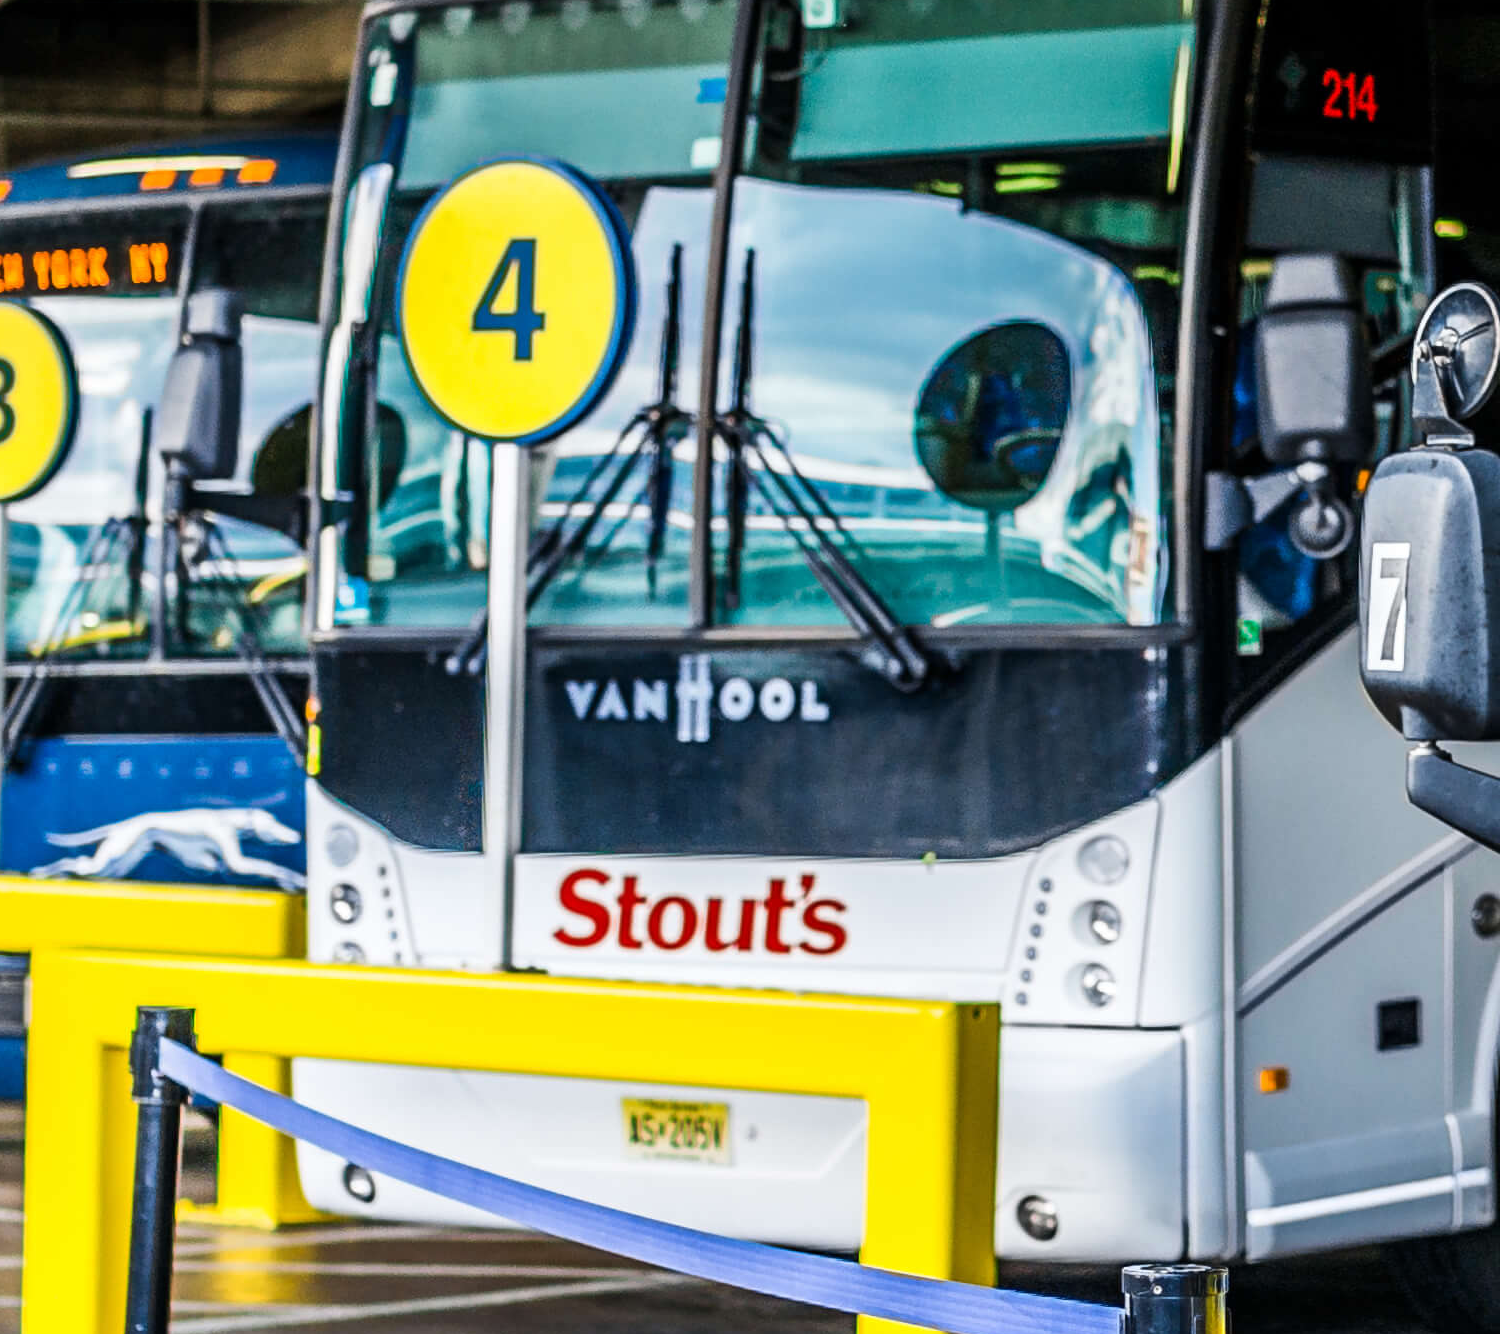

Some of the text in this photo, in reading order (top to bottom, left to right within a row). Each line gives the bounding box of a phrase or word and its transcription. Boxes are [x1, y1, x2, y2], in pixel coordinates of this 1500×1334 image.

[1323, 69, 1378, 122] 214
[32, 247, 110, 291] YORK
[129, 242, 169, 284] NY
[472, 238, 546, 362] 4
[553, 869, 847, 955] Stout's
